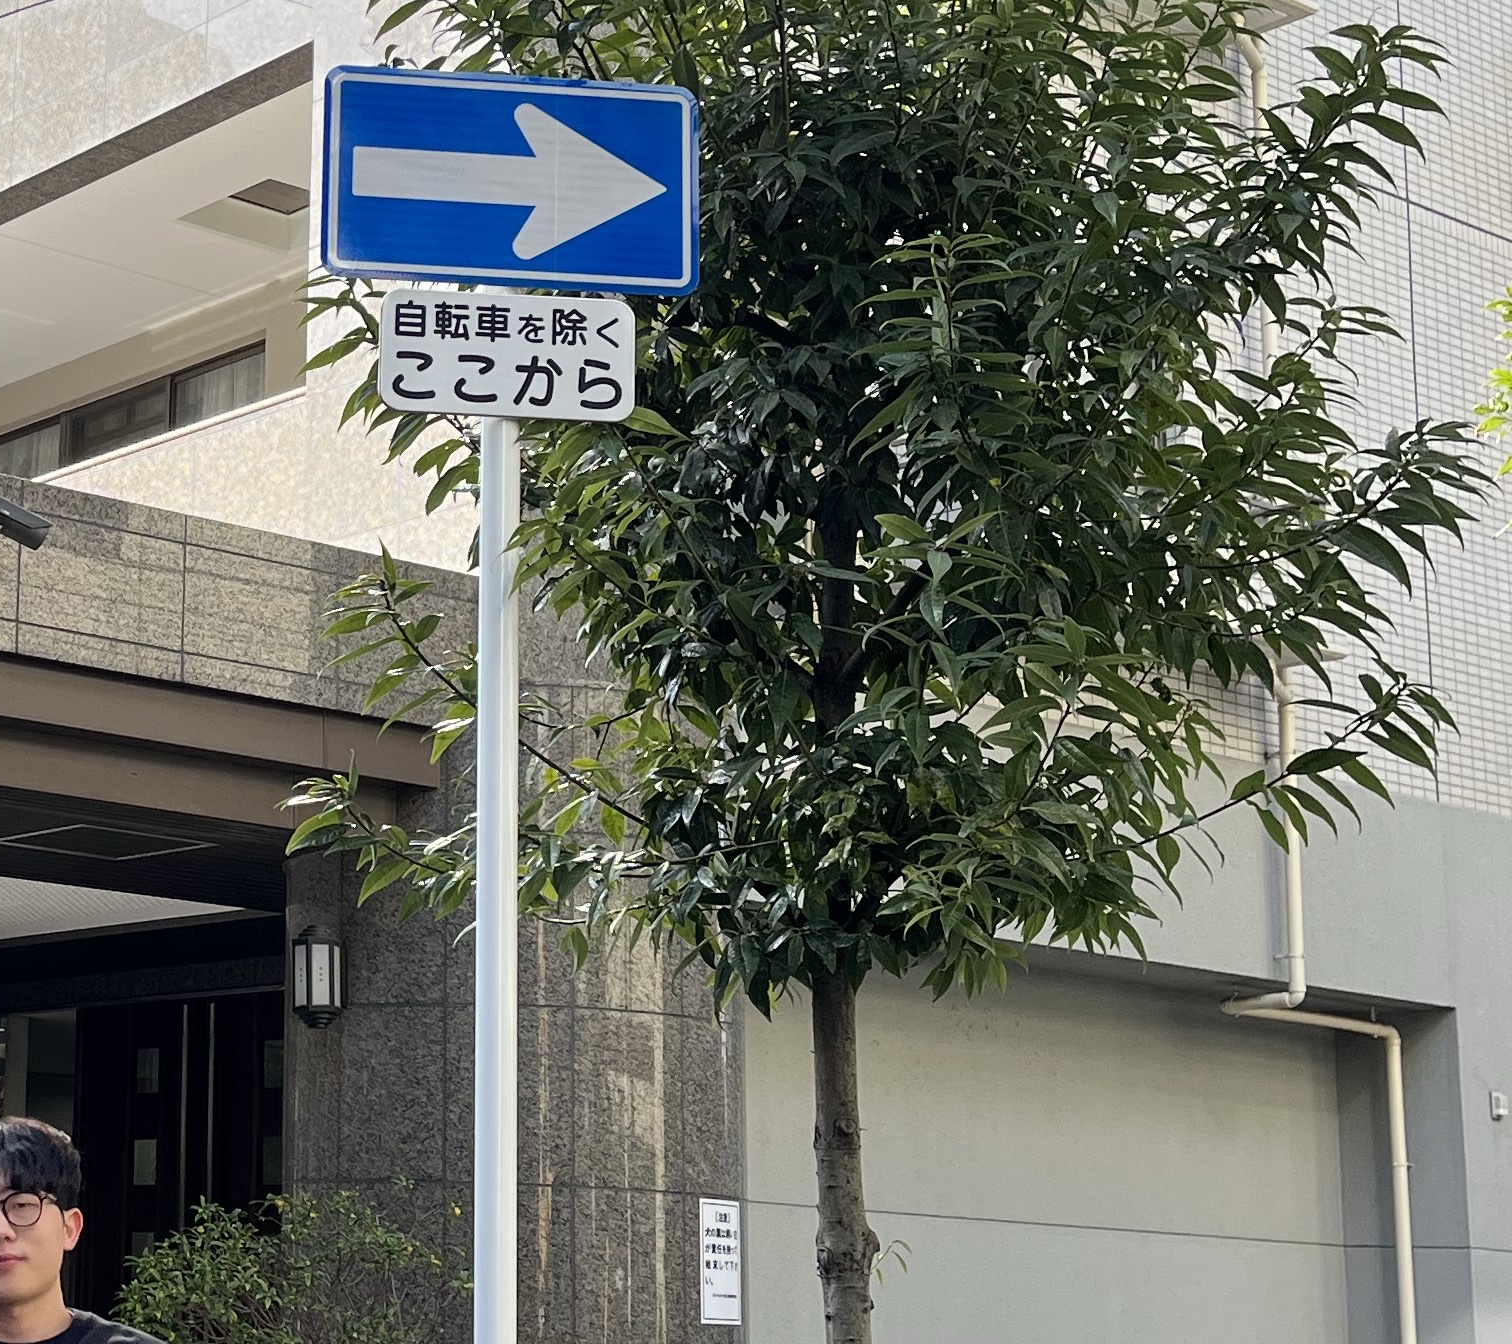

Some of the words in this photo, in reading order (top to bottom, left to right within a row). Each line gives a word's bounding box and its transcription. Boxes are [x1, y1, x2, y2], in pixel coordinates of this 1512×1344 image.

[394, 300, 619, 348] 自転車を除く
[392, 350, 622, 410] ここから
